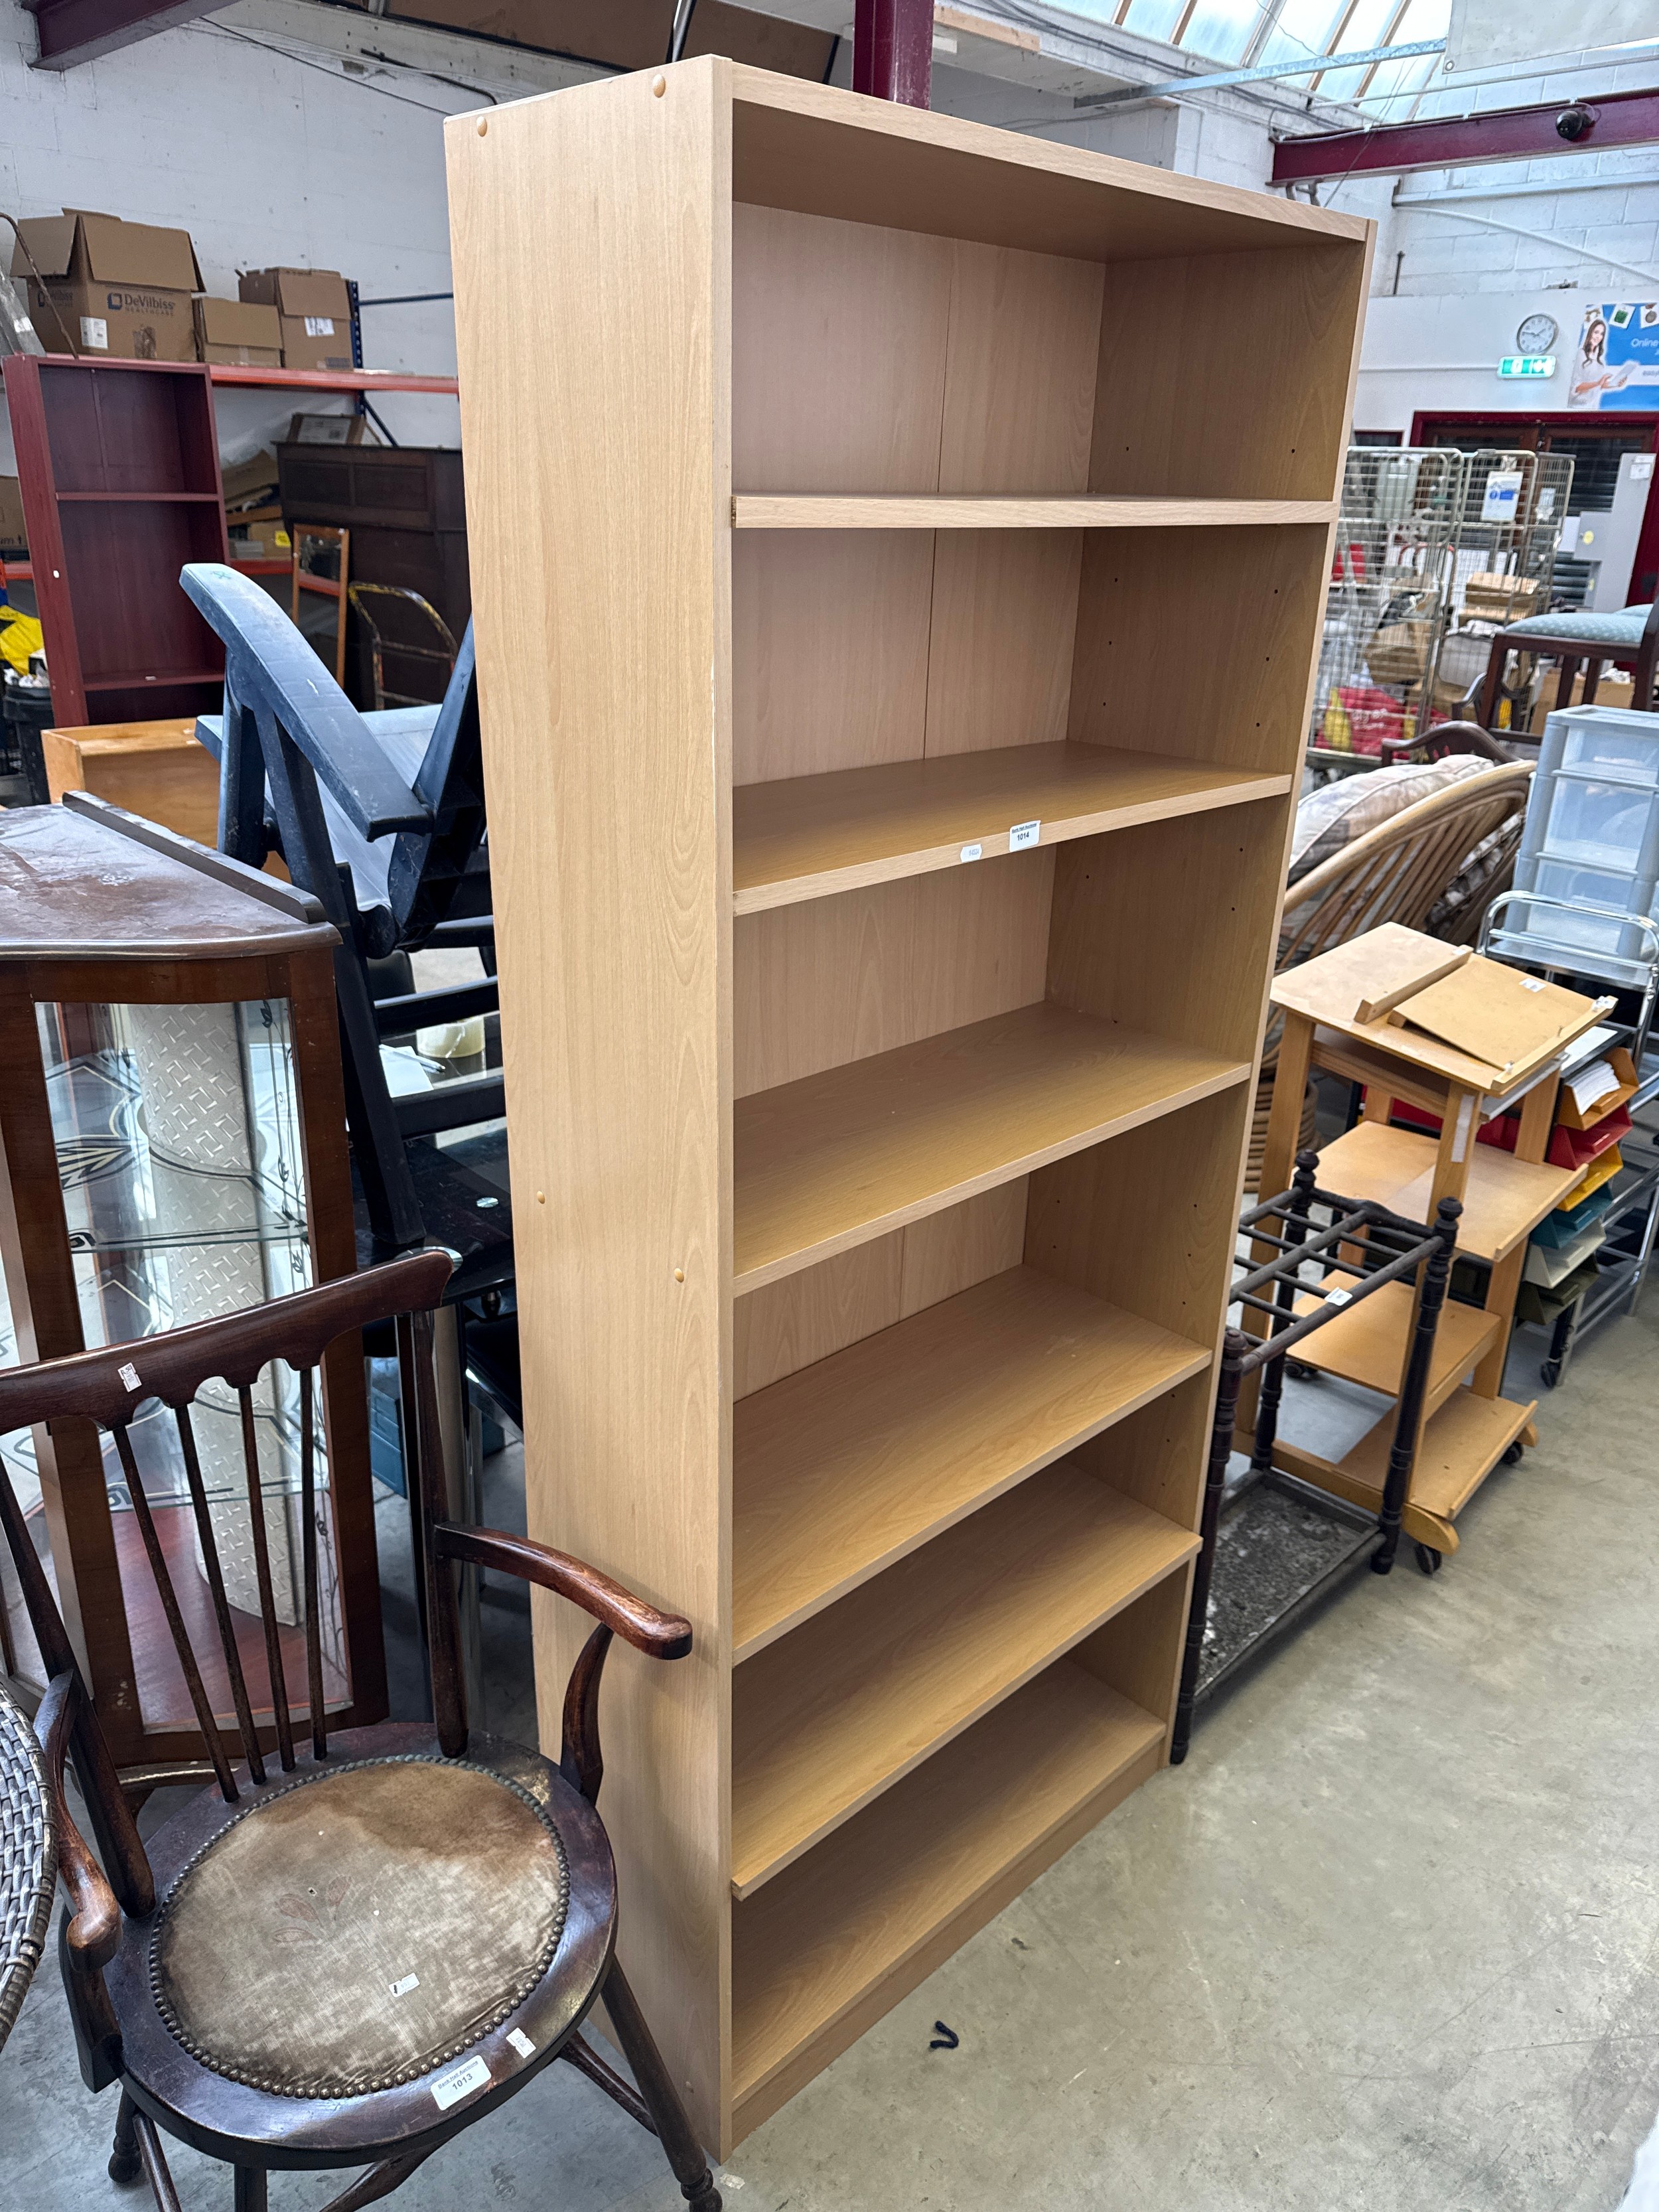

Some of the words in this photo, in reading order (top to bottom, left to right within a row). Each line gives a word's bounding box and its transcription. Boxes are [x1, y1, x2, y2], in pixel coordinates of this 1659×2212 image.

[124, 293, 174, 310] DeVilbiss
[125, 306, 175, 317] HEALTHCARE
[1631, 338, 1658, 348] Online
[1017, 831, 1029, 841] 1014
[449, 2072, 459, 2081] Hall
[459, 2060, 479, 2075] Auctions
[452, 2073, 473, 2090] 1013
